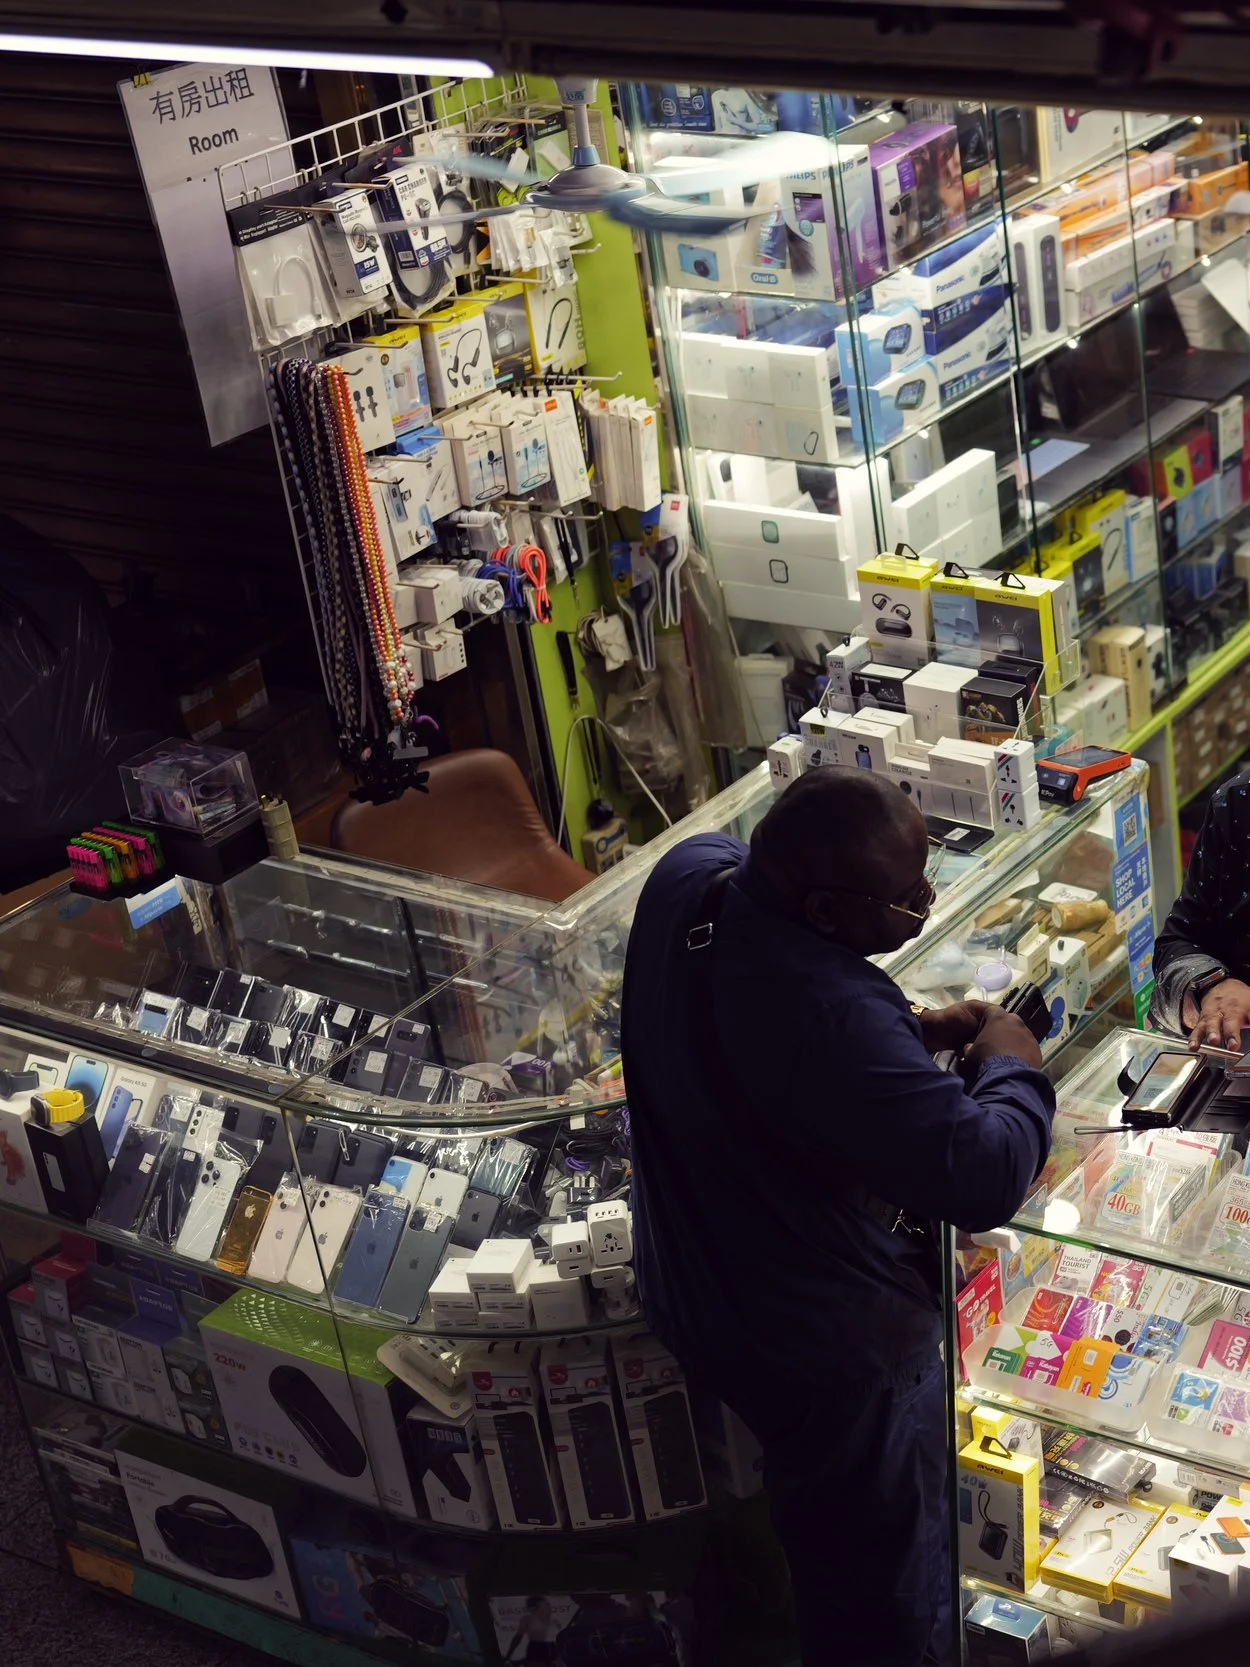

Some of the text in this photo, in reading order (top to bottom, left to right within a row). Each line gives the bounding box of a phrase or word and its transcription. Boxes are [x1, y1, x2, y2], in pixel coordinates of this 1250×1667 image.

[149, 68, 254, 124] 有房出租
[189, 128, 239, 155] Room
[363, 258, 375, 269] 15W
[751, 273, 779, 285] Oral-B
[936, 275, 965, 293] Panasonic
[943, 352, 971, 370] Panasonic
[1041, 788, 1055, 799] KPay
[1115, 868, 1133, 888] SHOP
[1116, 878, 1136, 898] LOCAL
[1117, 889, 1134, 909] HERE
[1232, 1178, 1245, 1187] HONG
[1108, 1193, 1141, 1216] 40GB
[1062, 1260, 1090, 1270] TOURIST
[1063, 1255, 1092, 1264] THAILAND
[1114, 1310, 1125, 1323] $50
[1233, 1304, 1247, 1323] 5G
[1040, 1336, 1054, 1348] 5G
[1225, 1335, 1248, 1371] $100
[976, 1463, 1004, 1475] awei
